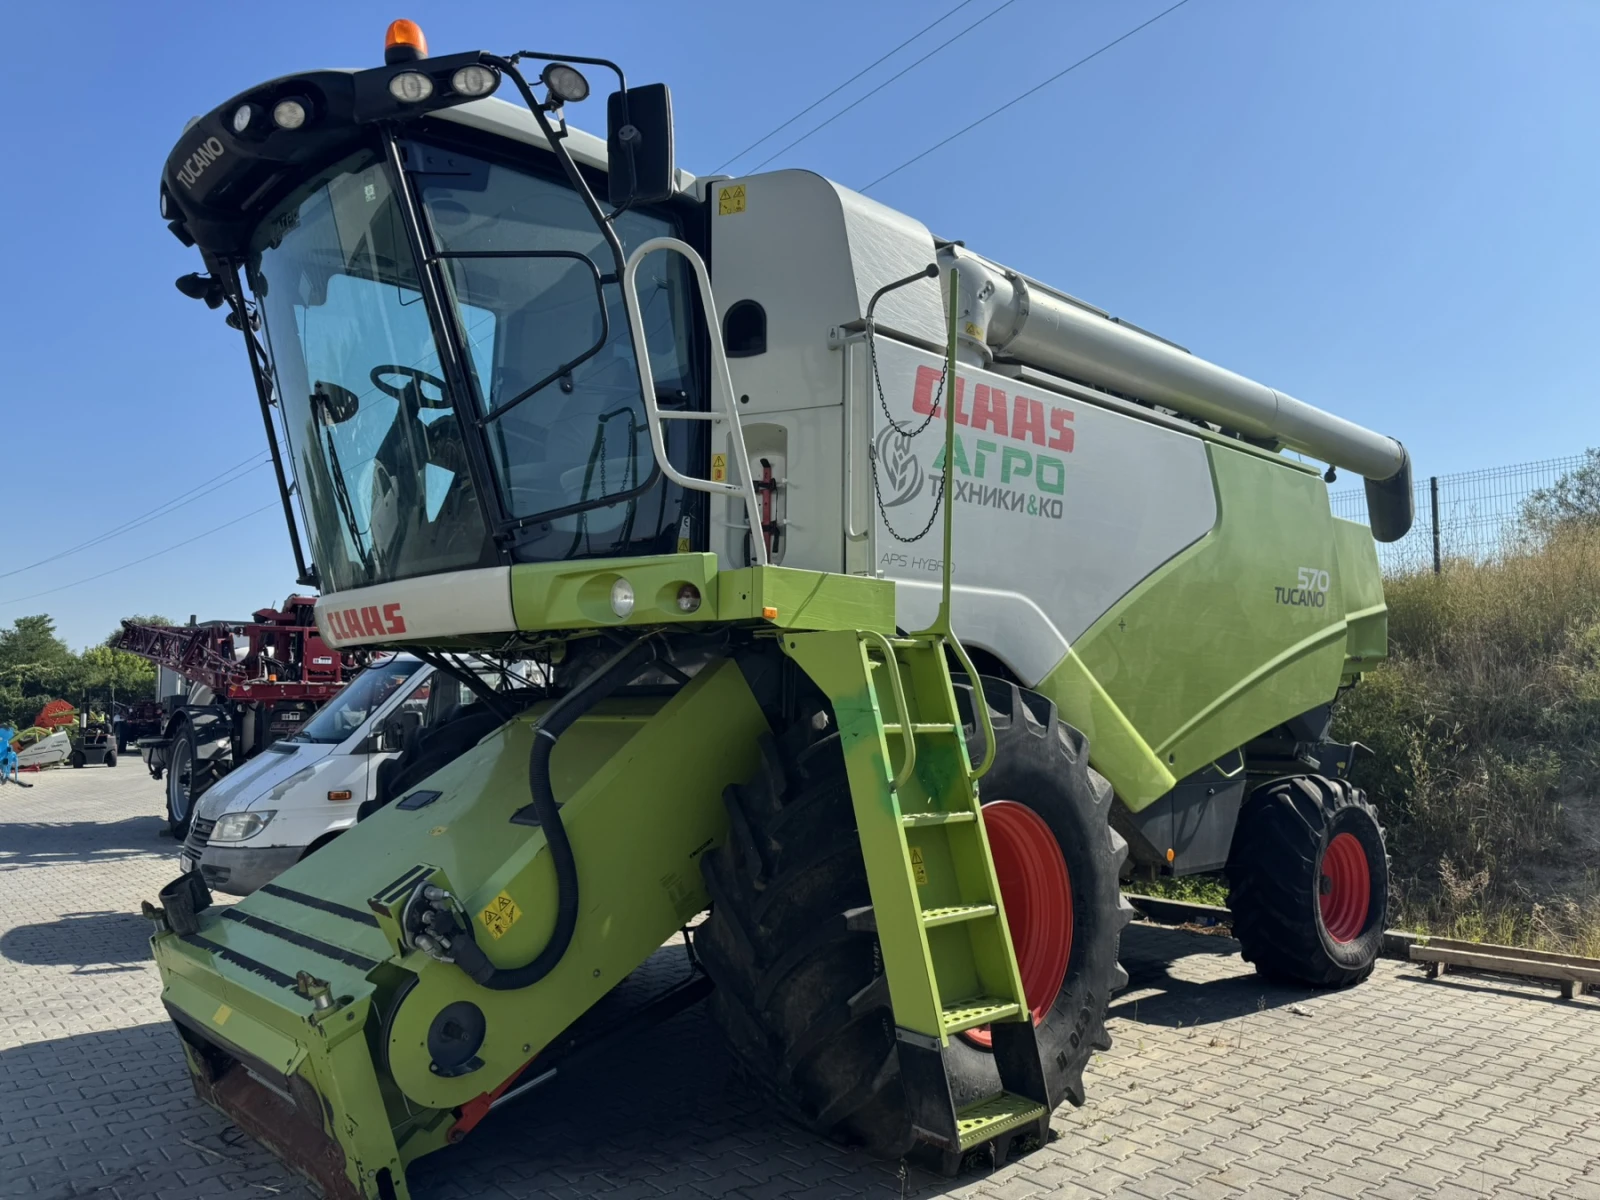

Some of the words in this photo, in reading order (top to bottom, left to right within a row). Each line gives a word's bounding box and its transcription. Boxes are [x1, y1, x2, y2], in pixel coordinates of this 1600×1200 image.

[176, 136, 225, 190] TUCANO
[911, 364, 1075, 453] CLAAS
[932, 432, 1065, 495] АГРО
[928, 474, 1063, 519] ТХНИКИ&КО
[880, 552, 908, 567] APS
[911, 556, 956, 574] HYBR
[1297, 566, 1329, 592] 570
[1275, 586, 1325, 608] TUCANO
[327, 603, 407, 640] CLAAS
